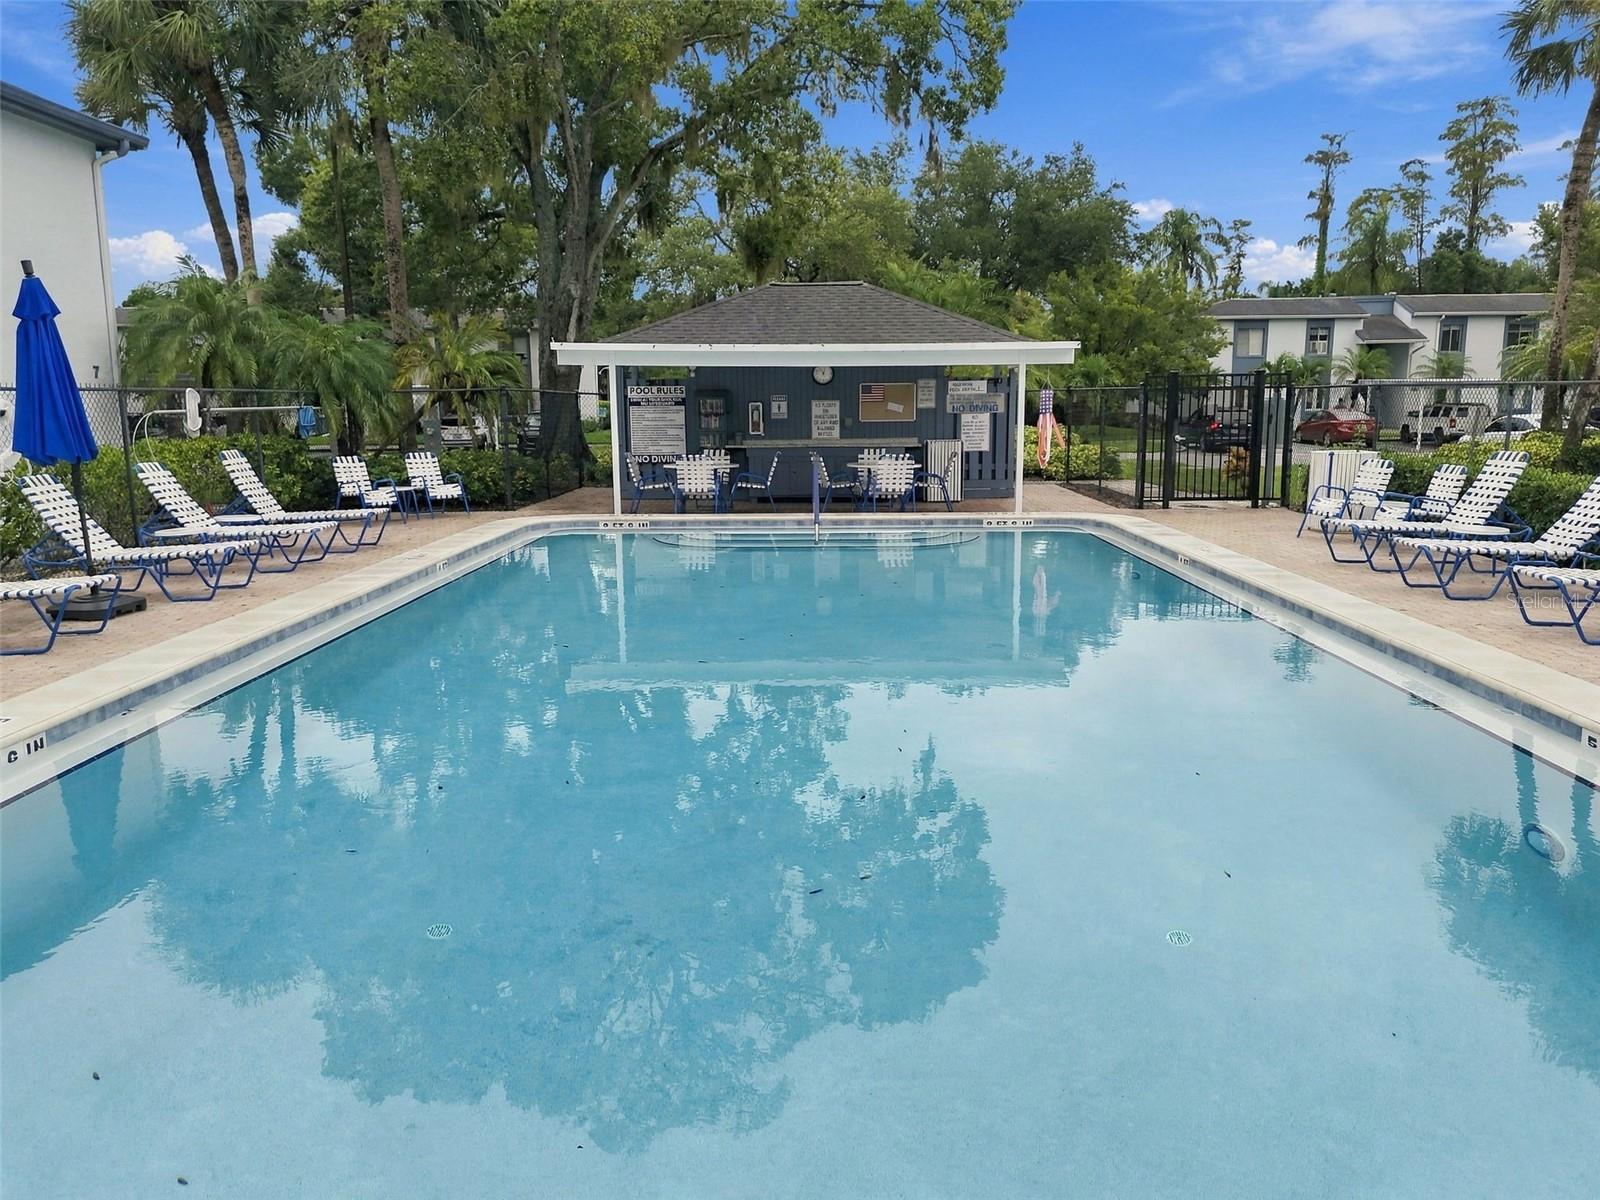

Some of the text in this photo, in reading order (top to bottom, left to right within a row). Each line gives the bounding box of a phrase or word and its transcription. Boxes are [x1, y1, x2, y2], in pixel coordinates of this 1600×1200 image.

[630, 387, 684, 395] POOL RULES
[952, 404, 999, 412] NO DIVING
[635, 455, 650, 463] NO
[26, 736, 44, 755] IN
